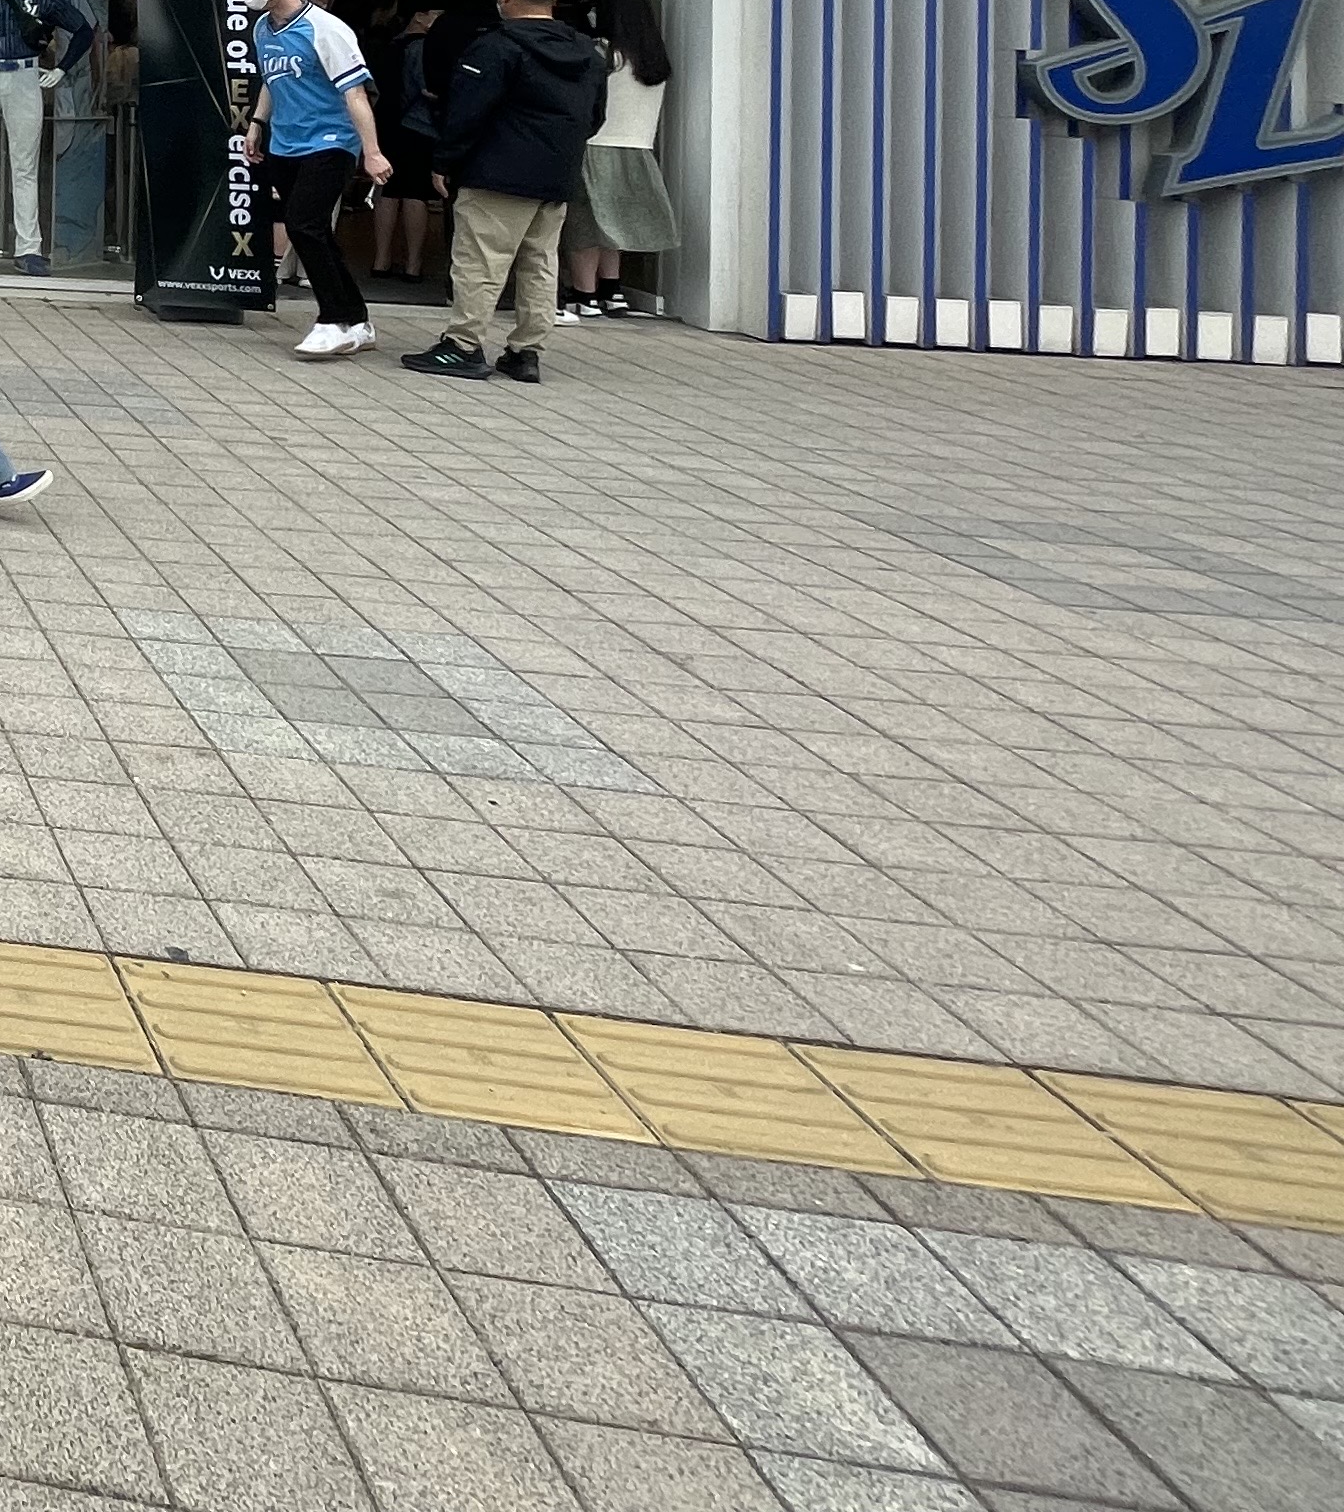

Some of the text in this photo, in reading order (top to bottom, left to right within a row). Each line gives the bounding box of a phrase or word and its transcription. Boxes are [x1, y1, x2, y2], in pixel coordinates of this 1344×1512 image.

[226, 40, 257, 75] of
[227, 268, 261, 281] VEXX
[158, 280, 261, 294] www.vexxsports.com
